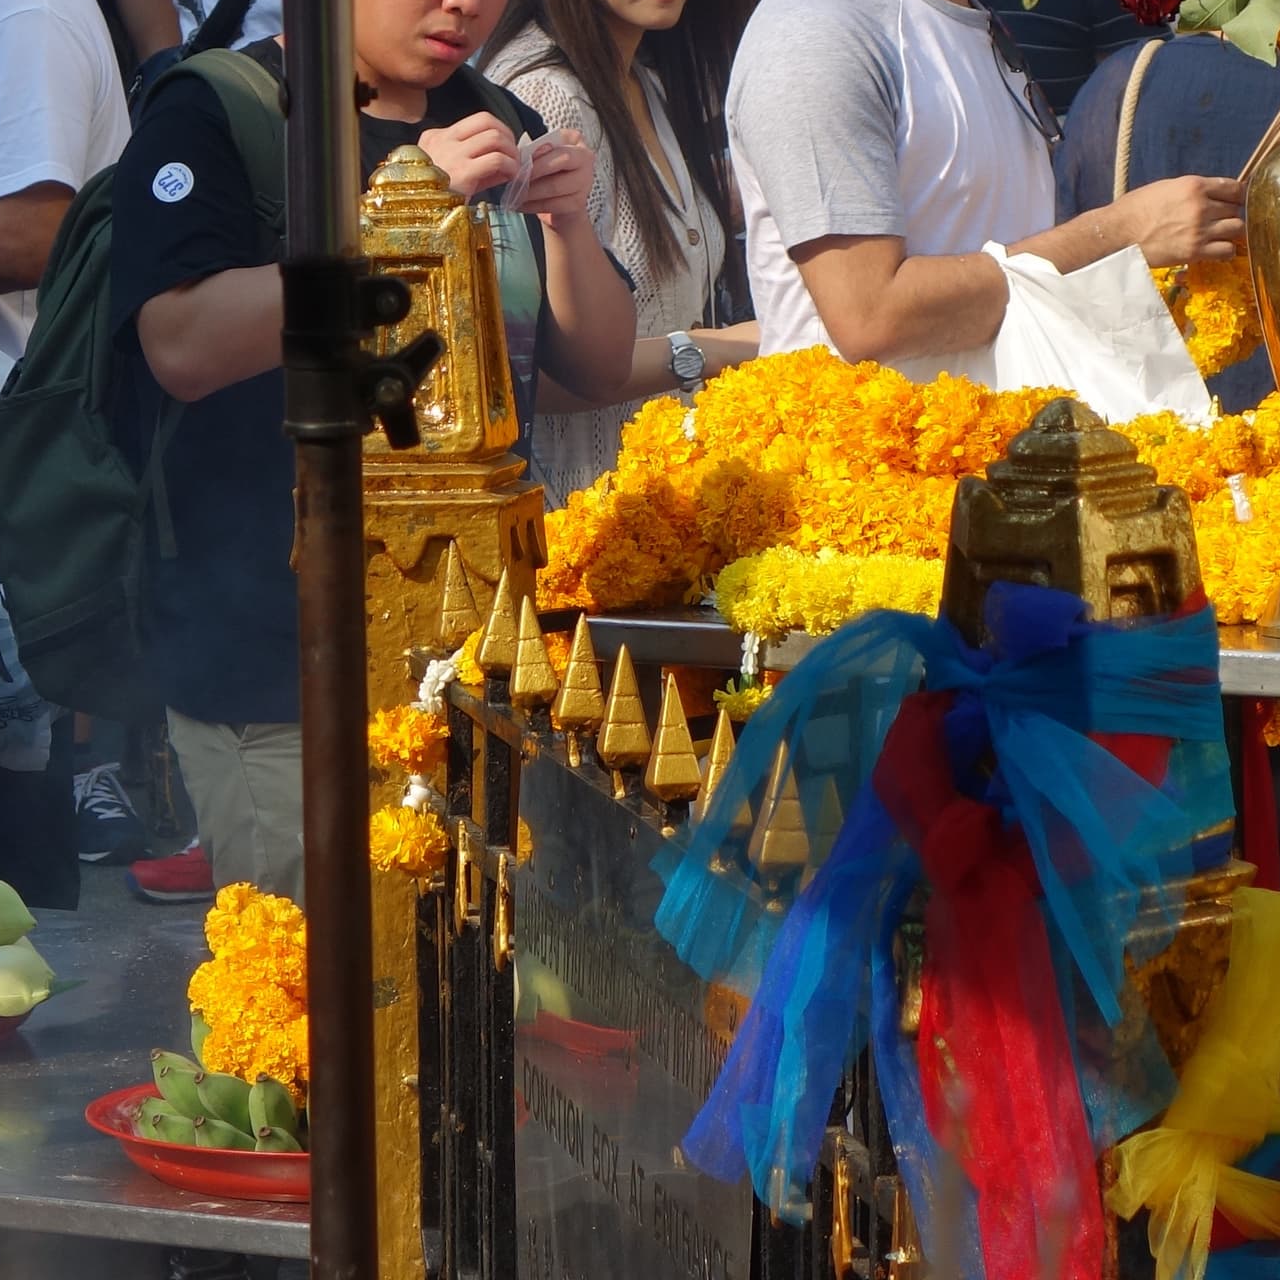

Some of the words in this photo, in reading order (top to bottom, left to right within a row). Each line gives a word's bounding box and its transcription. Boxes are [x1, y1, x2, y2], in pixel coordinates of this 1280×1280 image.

[523, 1055, 585, 1168] DONATION
[592, 1121, 620, 1209] BOX
[629, 1159, 646, 1227] AT
